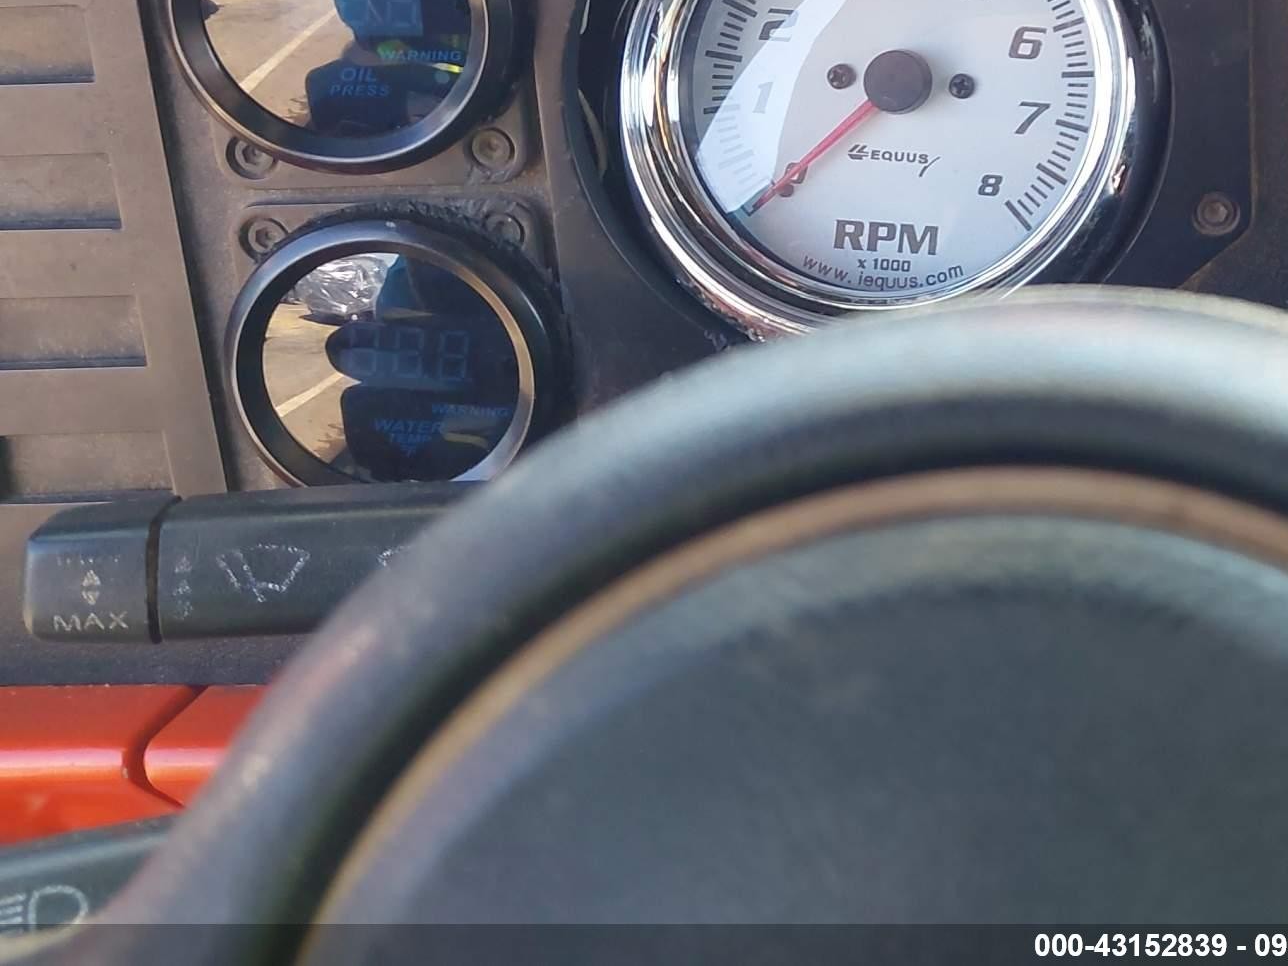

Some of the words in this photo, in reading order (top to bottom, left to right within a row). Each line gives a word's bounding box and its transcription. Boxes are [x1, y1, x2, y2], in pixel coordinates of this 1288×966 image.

[758, 8, 797, 42] 2
[1009, 26, 1046, 60] 6
[380, 49, 463, 62] WARNING
[340, 67, 378, 83] OIL
[329, 83, 391, 97] PRESS
[751, 81, 774, 114] 1
[1014, 101, 1050, 135] 7
[870, 149, 929, 164] EQUUS
[978, 175, 1003, 196] 8
[833, 219, 939, 256] RPM
[872, 258, 911, 272] 1000
[432, 403, 512, 418] WARNING
[374, 418, 444, 434] WATER
[53, 611, 129, 632] MAX
